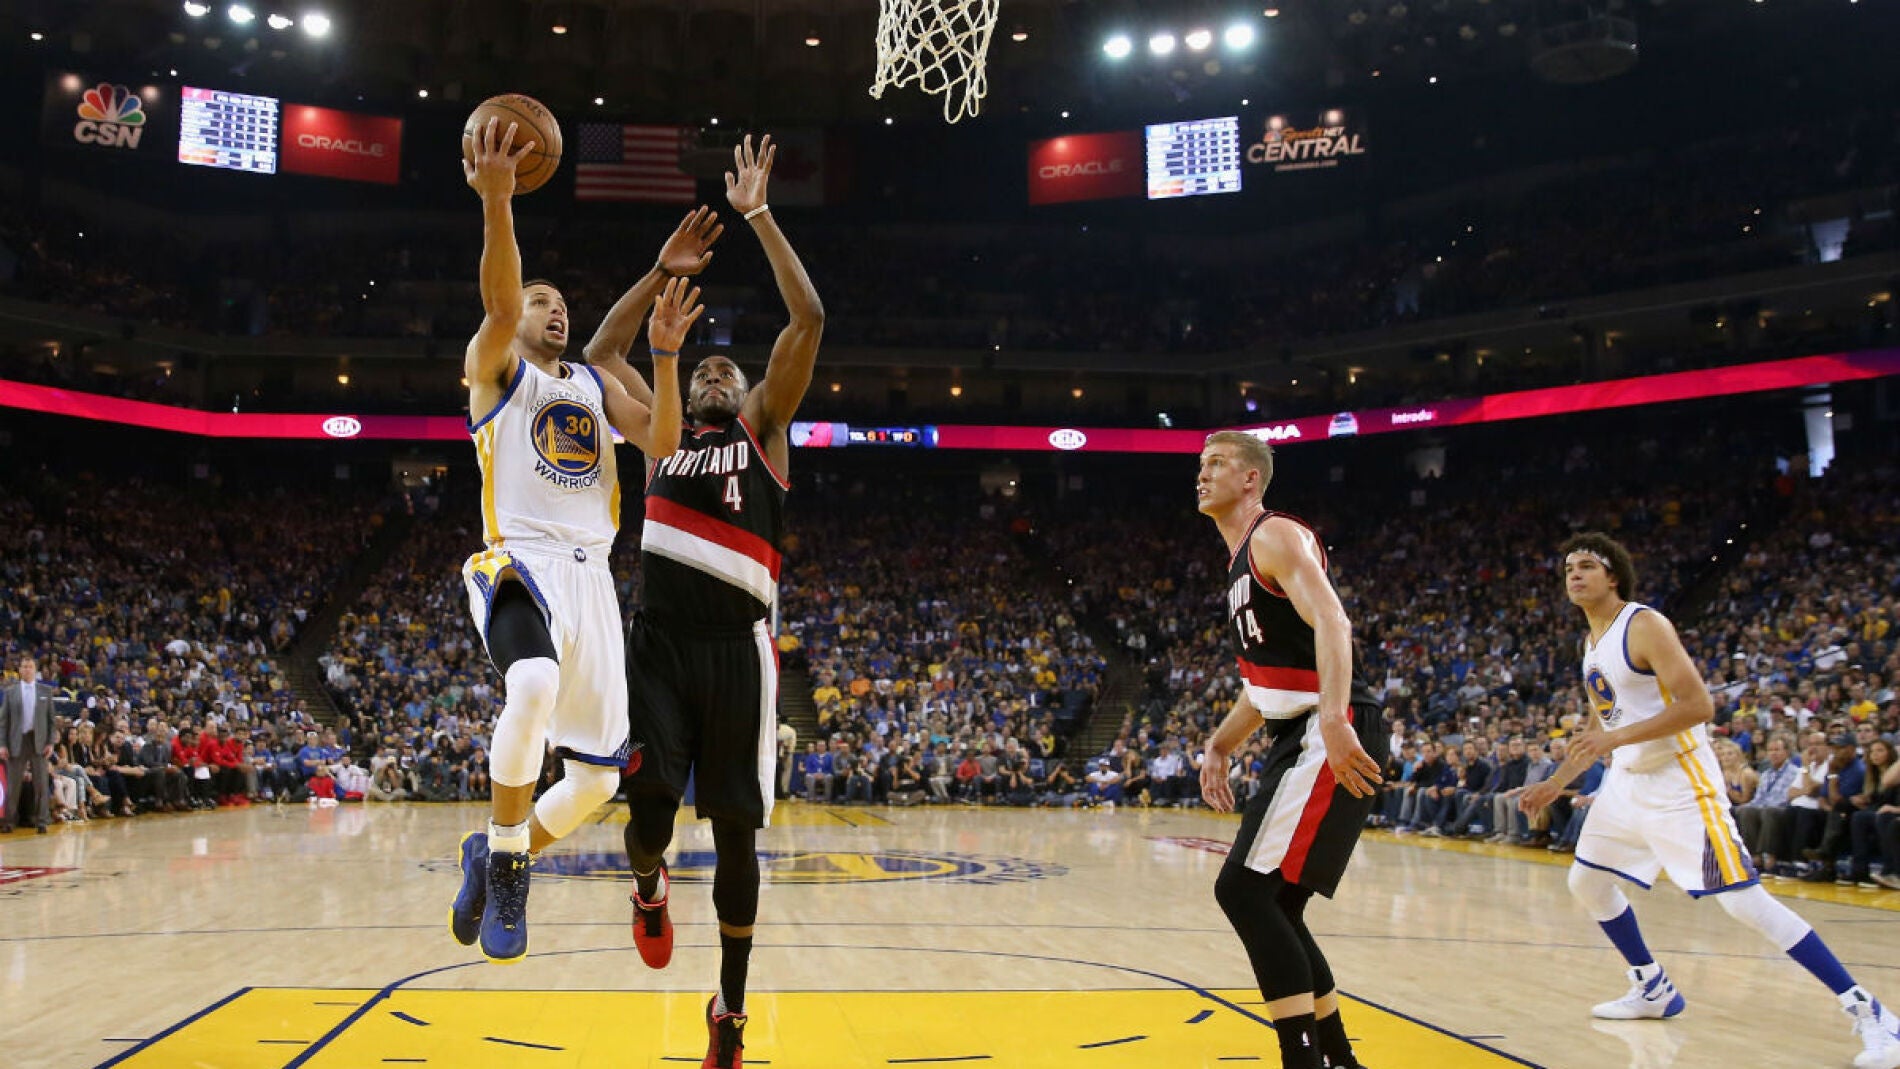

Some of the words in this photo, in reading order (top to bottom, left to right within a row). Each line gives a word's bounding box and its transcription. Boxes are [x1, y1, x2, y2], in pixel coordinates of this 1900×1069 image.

[75, 121, 143, 149] CSN
[298, 134, 385, 157] ORACLE
[1247, 134, 1365, 163] CENTRAL
[1039, 159, 1123, 179] ORACLE
[530, 390, 571, 415] GOLDEN
[327, 419, 357, 435] KIA
[565, 415, 592, 437] 30
[658, 441, 749, 478] PORTLAND
[724, 475, 743, 511] 4
